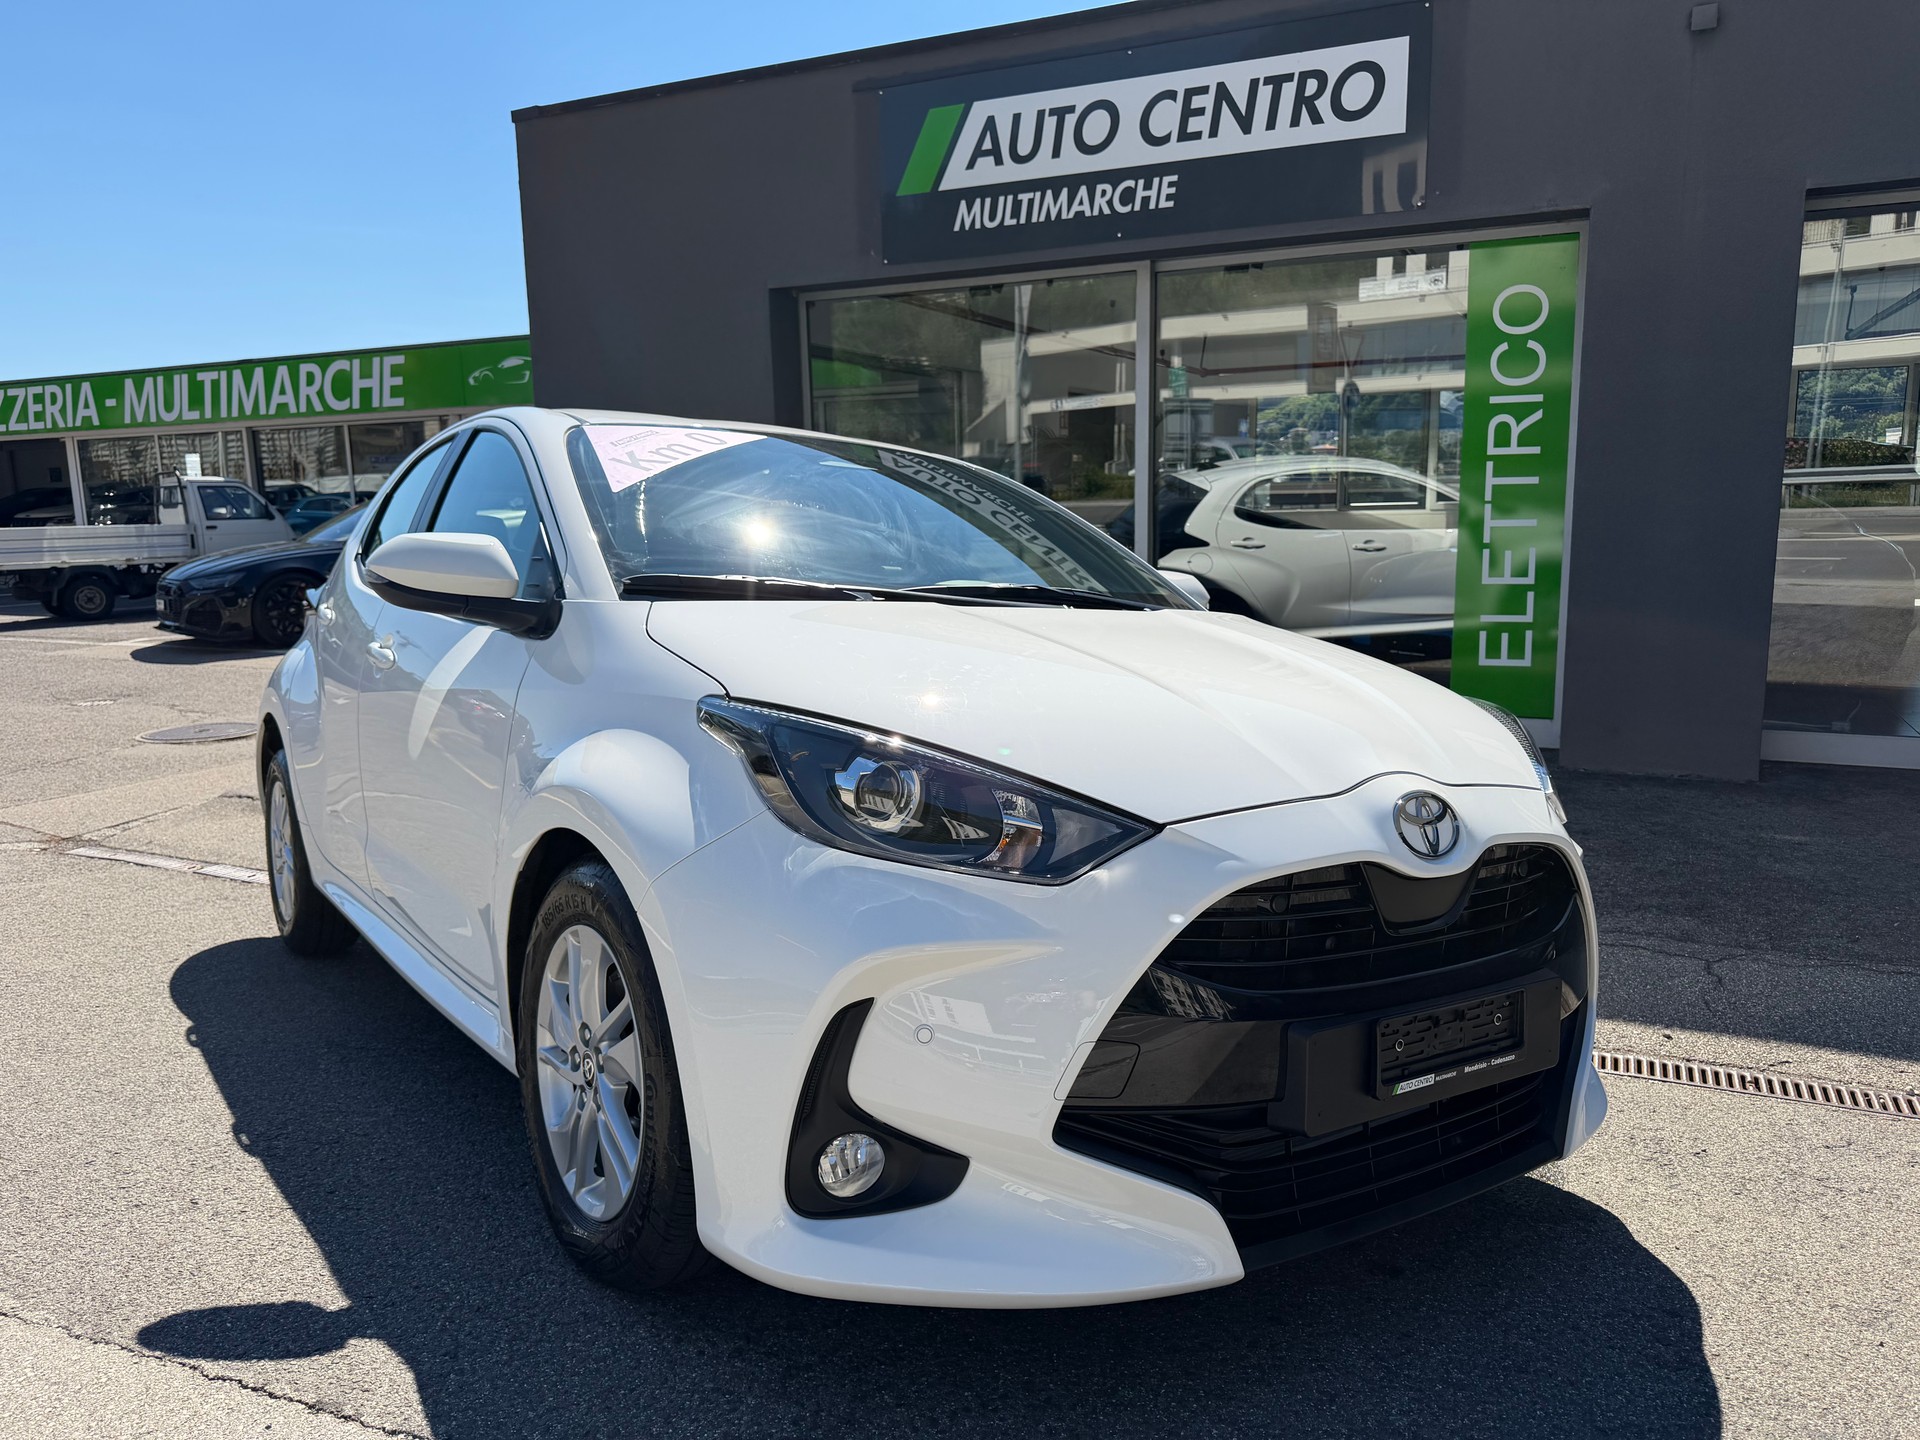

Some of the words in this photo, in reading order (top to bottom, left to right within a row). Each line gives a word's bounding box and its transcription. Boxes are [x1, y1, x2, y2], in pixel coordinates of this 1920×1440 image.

[965, 99, 1120, 170] AUTO
[1139, 60, 1386, 147] CENTRO
[953, 175, 1178, 232] MULTIMARCHE
[124, 355, 405, 424] MULTIMARCHE
[608, 443, 702, 472] Km
[1478, 284, 1550, 667] ELETTRICO
[1399, 1081, 1414, 1092] AUTO
[1414, 1075, 1434, 1087] CENTRO
